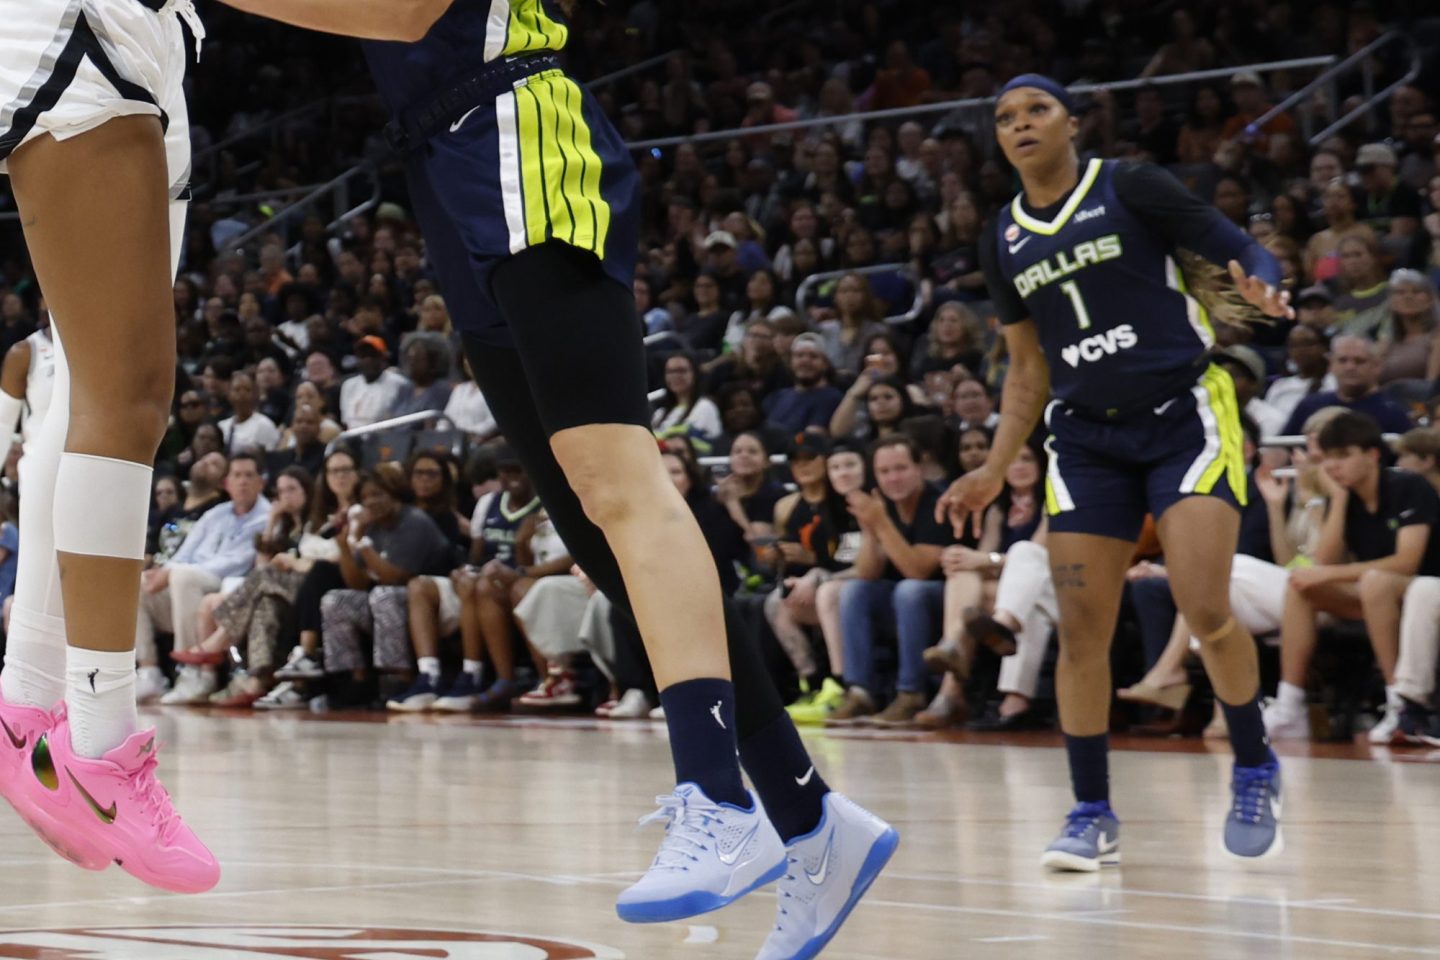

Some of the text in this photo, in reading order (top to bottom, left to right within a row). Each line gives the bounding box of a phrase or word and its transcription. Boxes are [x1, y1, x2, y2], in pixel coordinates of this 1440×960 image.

[1012, 233, 1123, 299] DALLAS
[1060, 279, 1091, 330] 1
[1078, 323, 1138, 362] CVS
